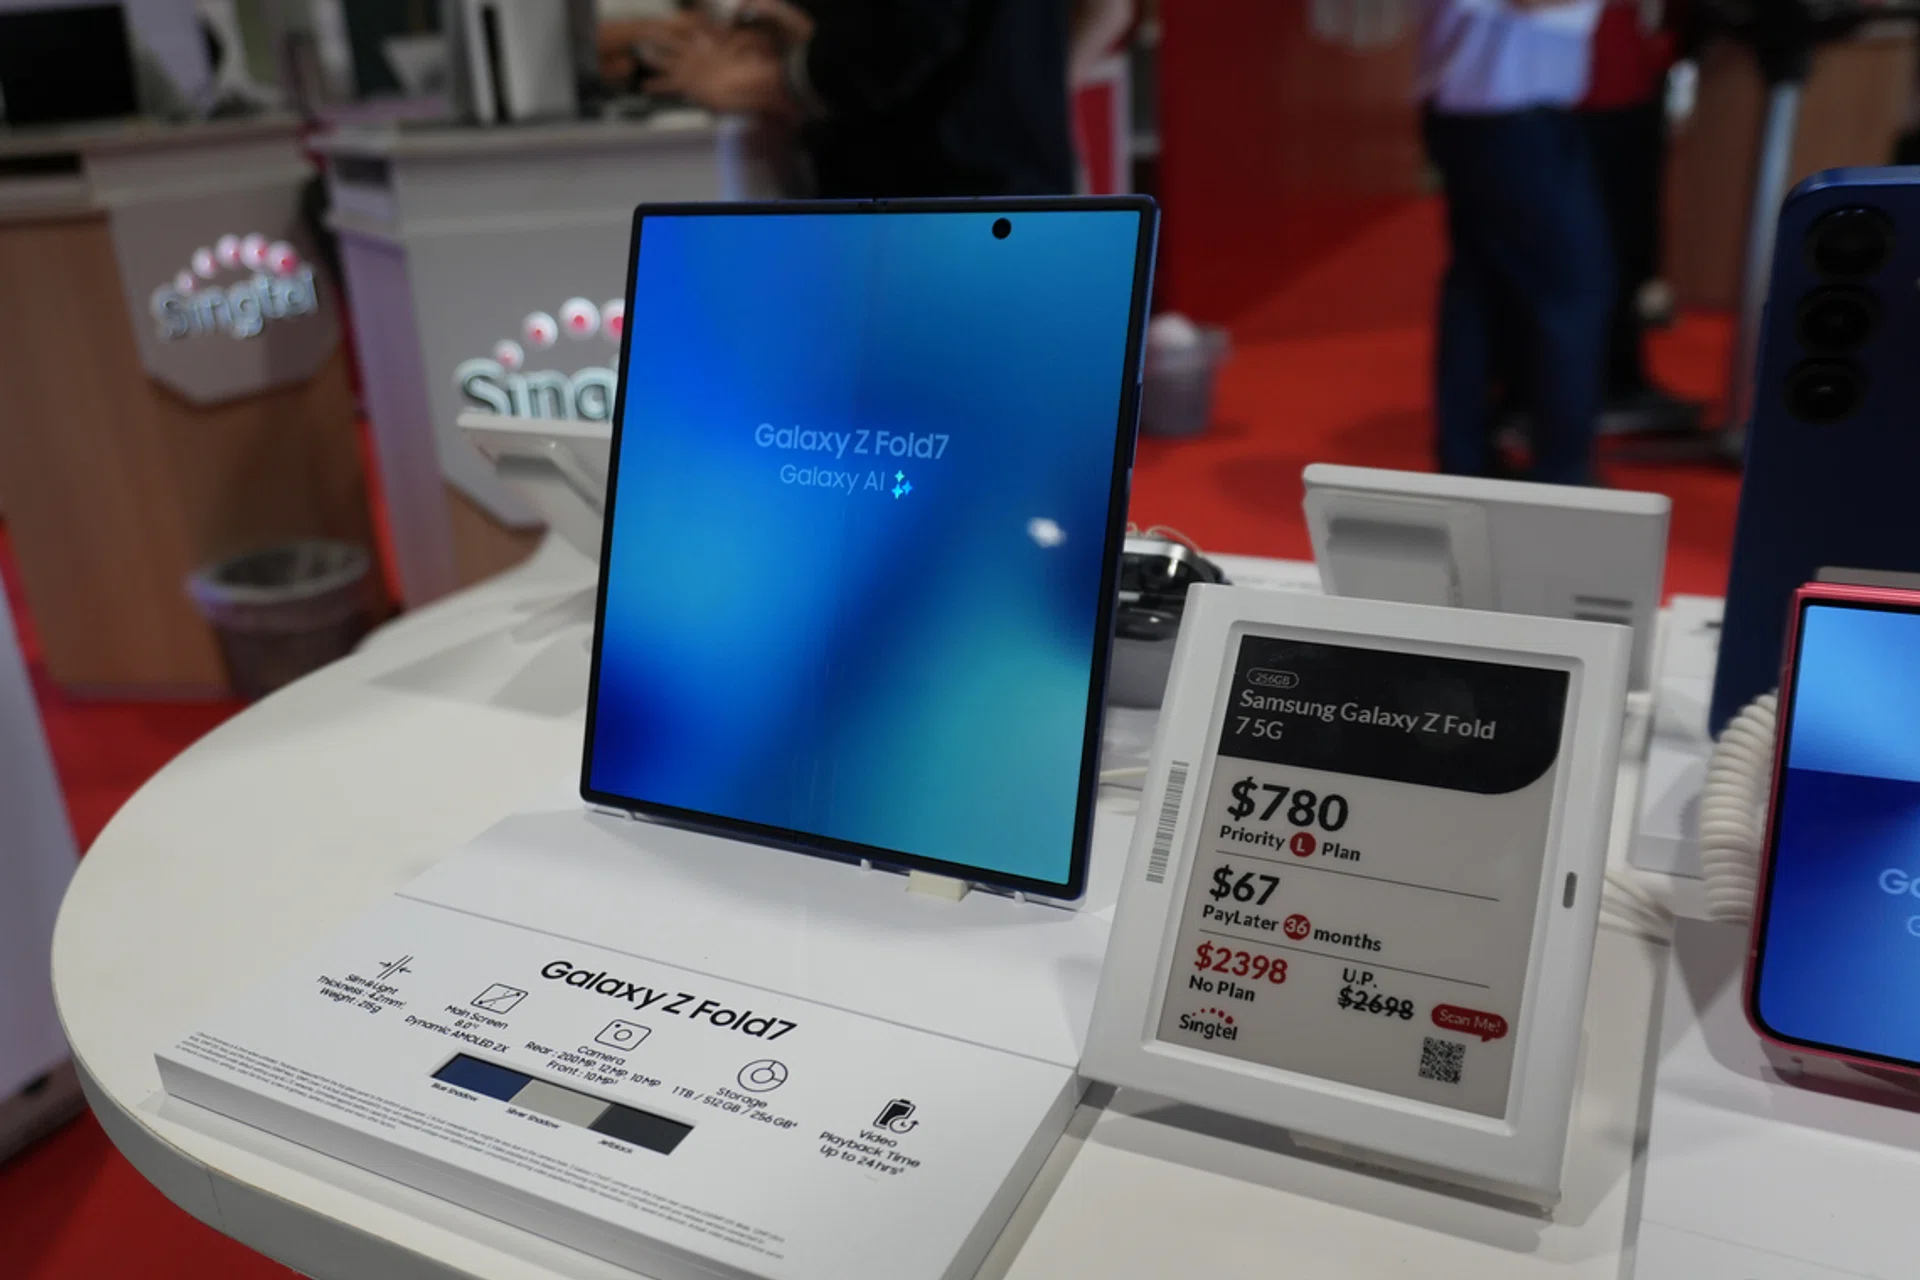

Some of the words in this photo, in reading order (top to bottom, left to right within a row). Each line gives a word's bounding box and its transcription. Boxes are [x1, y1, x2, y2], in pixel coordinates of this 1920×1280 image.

[755, 423, 851, 459] Galaxy
[854, 429, 870, 454] Z
[875, 430, 950, 460] Fold7
[779, 464, 860, 496] Galaxy
[863, 470, 886, 491] AI
[1255, 673, 1291, 686] 256GB
[1236, 716, 1251, 734] 7
[1252, 718, 1284, 740] 5G
[1240, 688, 1337, 722] Samsung
[1340, 702, 1419, 733] Galaxy
[1422, 712, 1441, 733] Z
[1443, 714, 1496, 740] Fold
[1226, 776, 1349, 832] $780
[1219, 824, 1286, 851] Priority
[1321, 841, 1361, 862] Plan
[1209, 864, 1281, 906] $67
[1202, 904, 1280, 932] PayLater
[1285, 918, 1308, 935] 36
[1313, 928, 1382, 952] months
[1194, 940, 1288, 985] $2398
[1189, 974, 1213, 993] No
[1217, 980, 1255, 1002] Plan
[1342, 967, 1377, 988] U.P.
[541, 960, 668, 1010] Galaxy
[661, 992, 695, 1015] Z
[689, 999, 798, 1041] Fold7
[1337, 985, 1415, 1021] $2698
[444, 1004, 470, 1019] Main
[470, 1012, 508, 1030] Screen
[1179, 1012, 1239, 1041] Singtel
[1439, 1009, 1471, 1028] Scan
[1473, 1016, 1502, 1034] Me!
[404, 1014, 451, 1036] Dynamic
[450, 1030, 495, 1049] AMOLED
[492, 1042, 510, 1054] 2X
[525, 1040, 554, 1055] Rear
[546, 1059, 580, 1076] Front
[577, 1045, 626, 1066] Camera
[716, 1086, 769, 1110] Storage
[819, 1130, 883, 1157] Playback
[886, 1150, 921, 1168] Time
[859, 1128, 898, 1148] Video
[820, 1144, 839, 1158] Up
[841, 1151, 856, 1162] to
